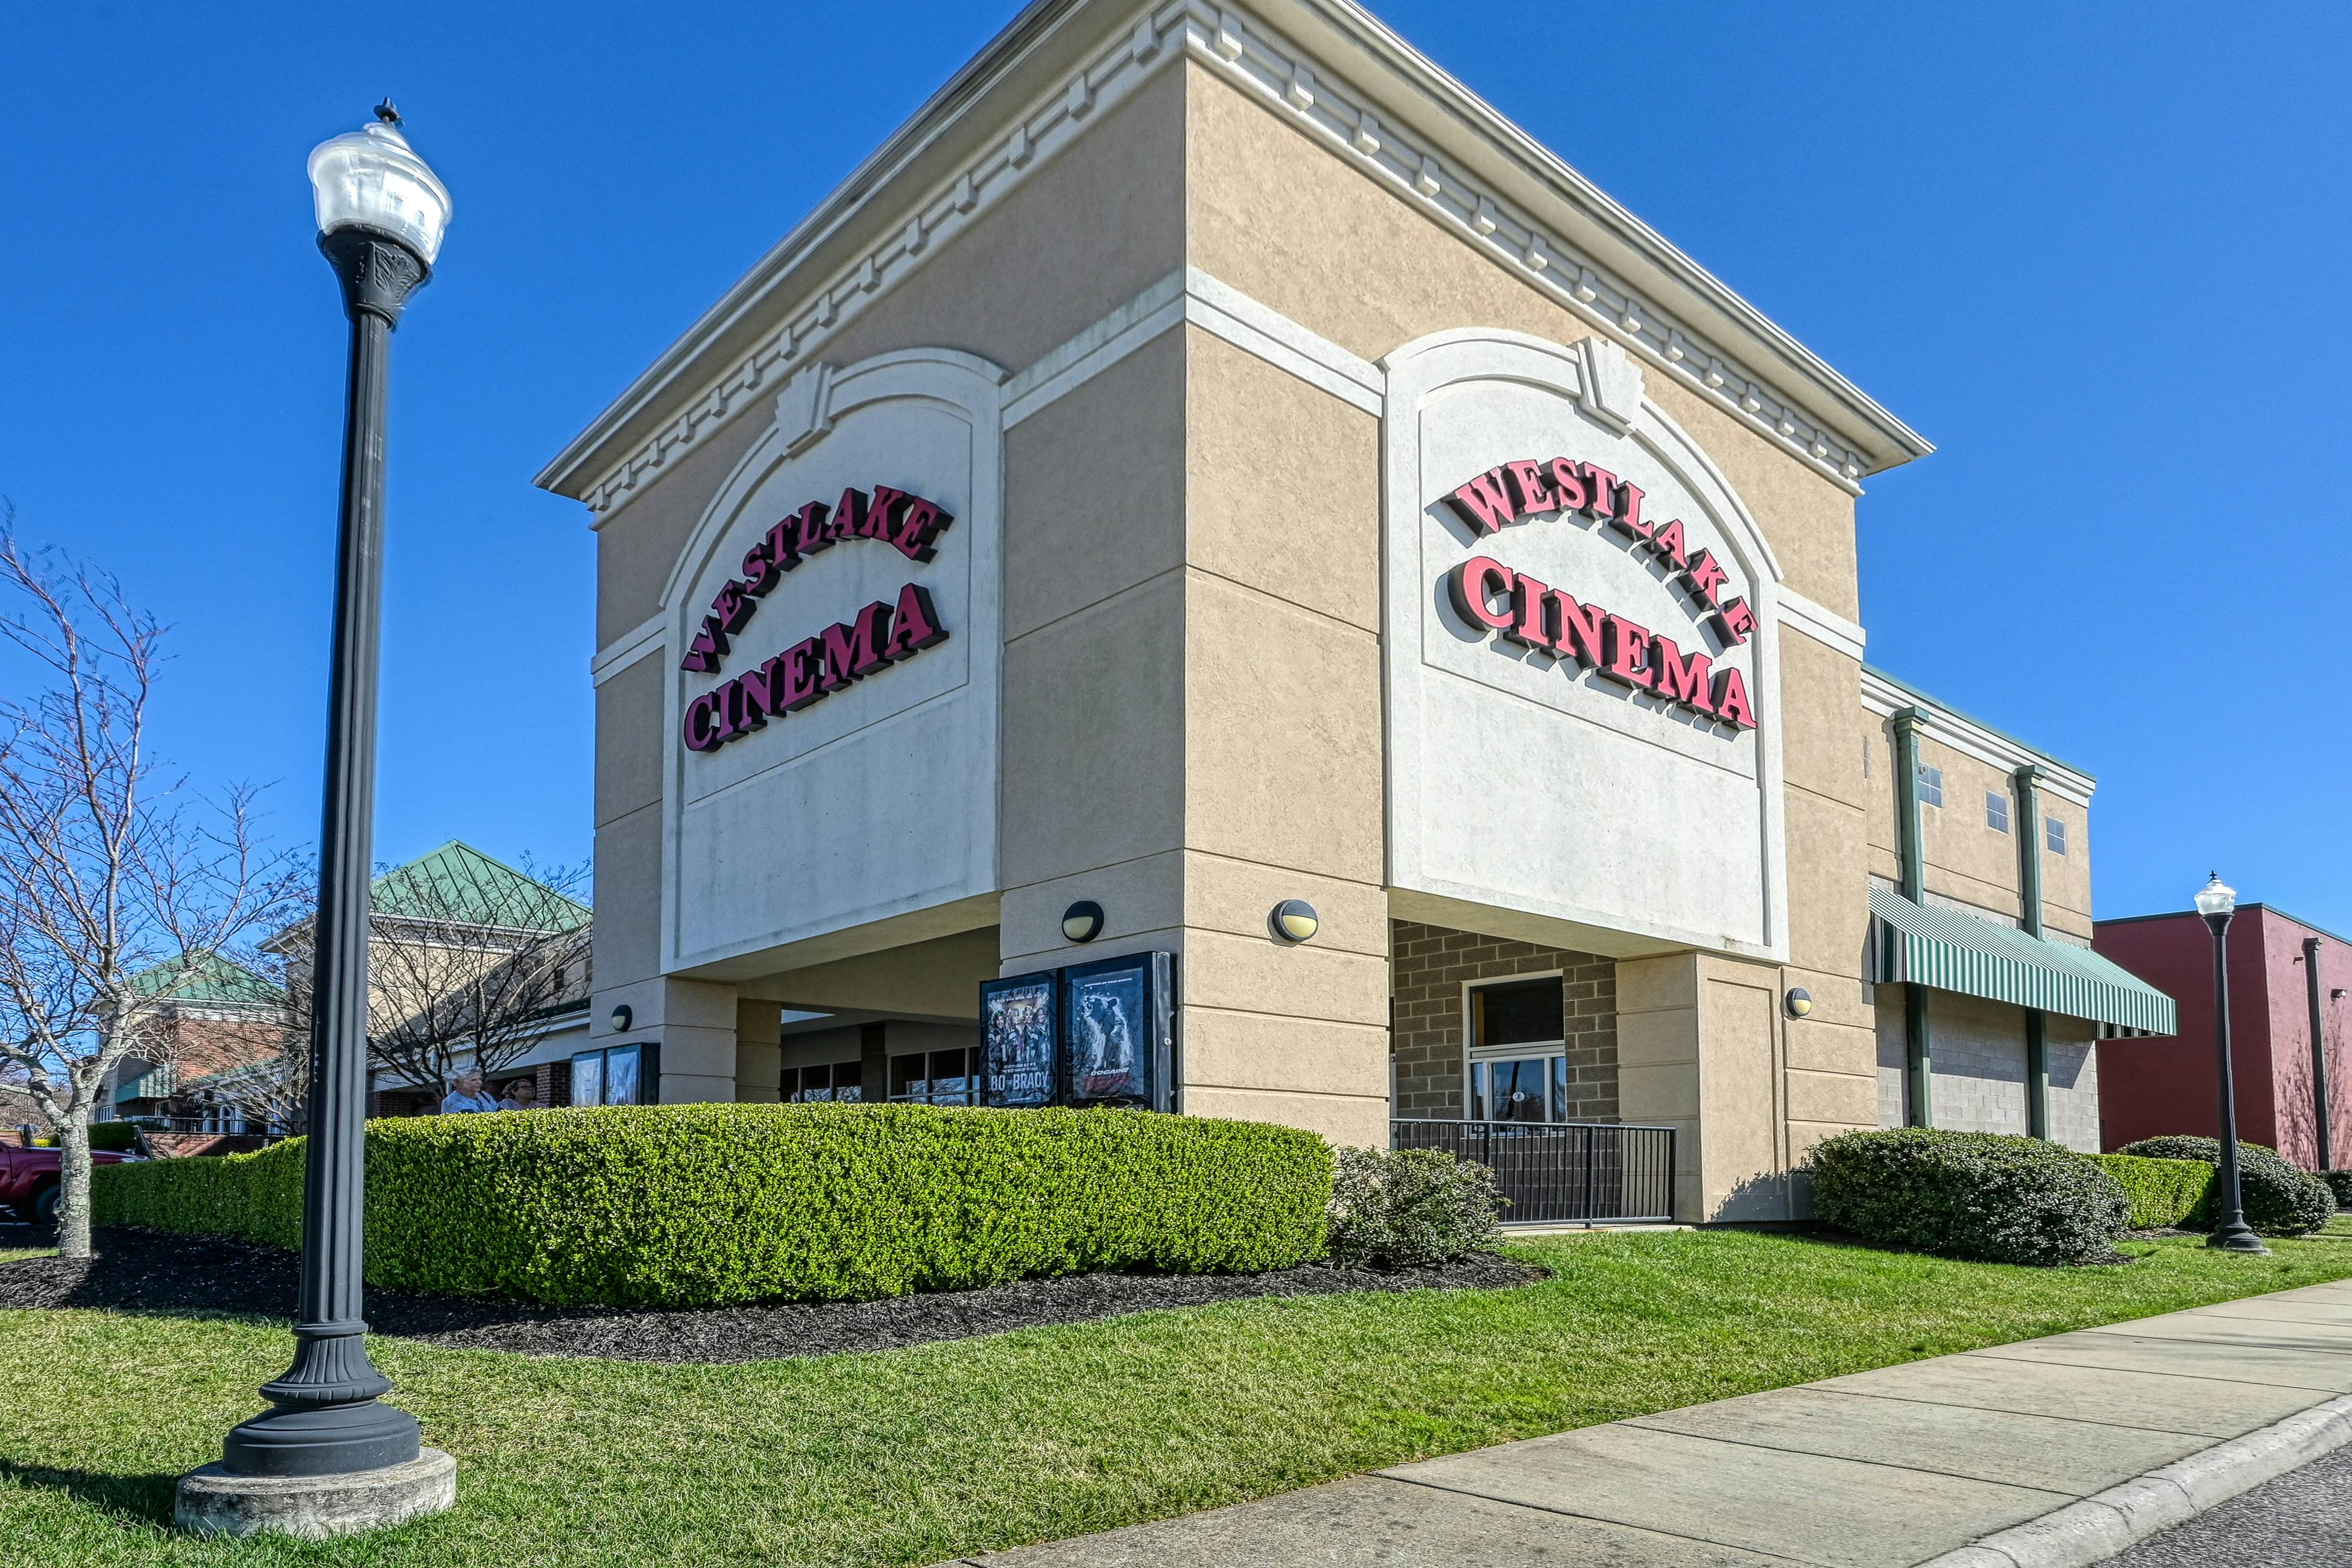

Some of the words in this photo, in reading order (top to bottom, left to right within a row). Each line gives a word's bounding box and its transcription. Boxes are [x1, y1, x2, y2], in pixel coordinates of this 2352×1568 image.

[681, 484, 948, 673] WESTLAKE
[1455, 457, 1760, 644] WESTLAKE
[683, 583, 944, 751] CINEMA
[1459, 555, 1757, 729] CINEMA
[991, 1075, 1005, 1091] 80
[1013, 1071, 1049, 1090] BRADY
